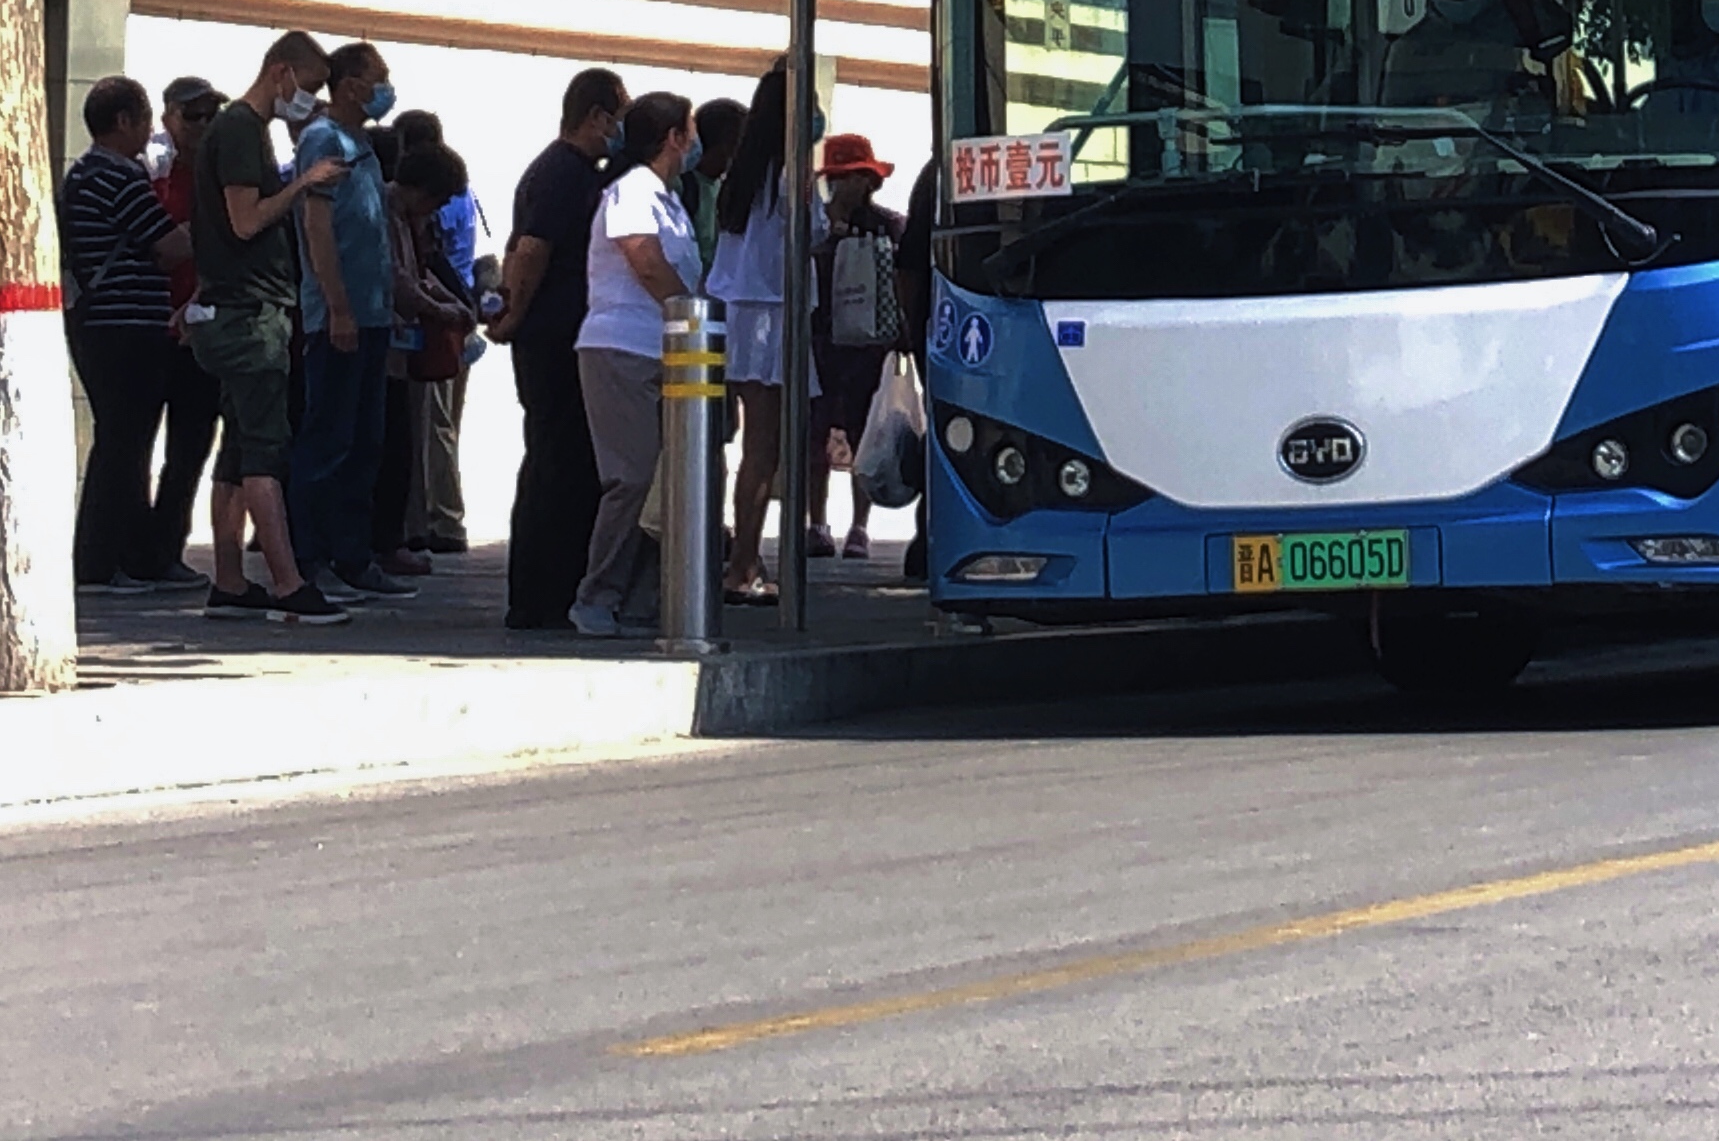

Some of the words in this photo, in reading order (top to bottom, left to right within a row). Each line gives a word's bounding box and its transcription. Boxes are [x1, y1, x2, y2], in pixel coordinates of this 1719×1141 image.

[956, 140, 1065, 195] 投币壹元
[1287, 437, 1353, 465] BYD
